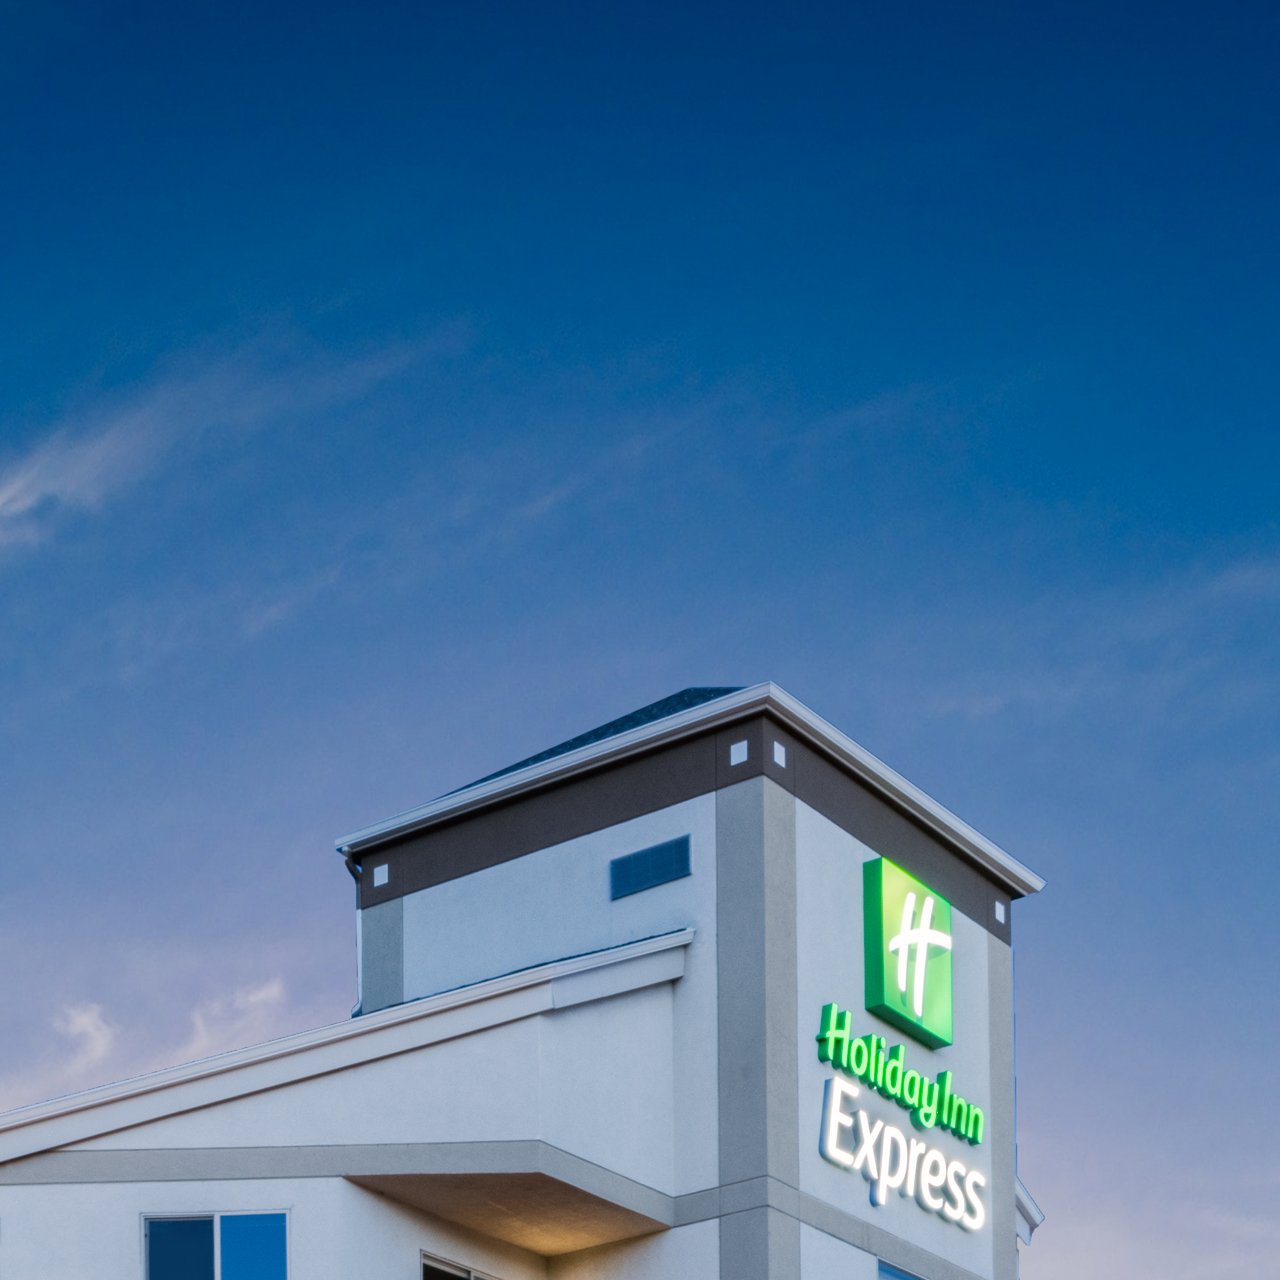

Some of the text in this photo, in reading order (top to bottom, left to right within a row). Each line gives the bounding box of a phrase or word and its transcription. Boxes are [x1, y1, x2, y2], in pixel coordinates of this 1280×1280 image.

[888, 892, 952, 1016] H
[821, 1002, 984, 1144] Holiday Inn
[823, 1077, 986, 1230] Express
